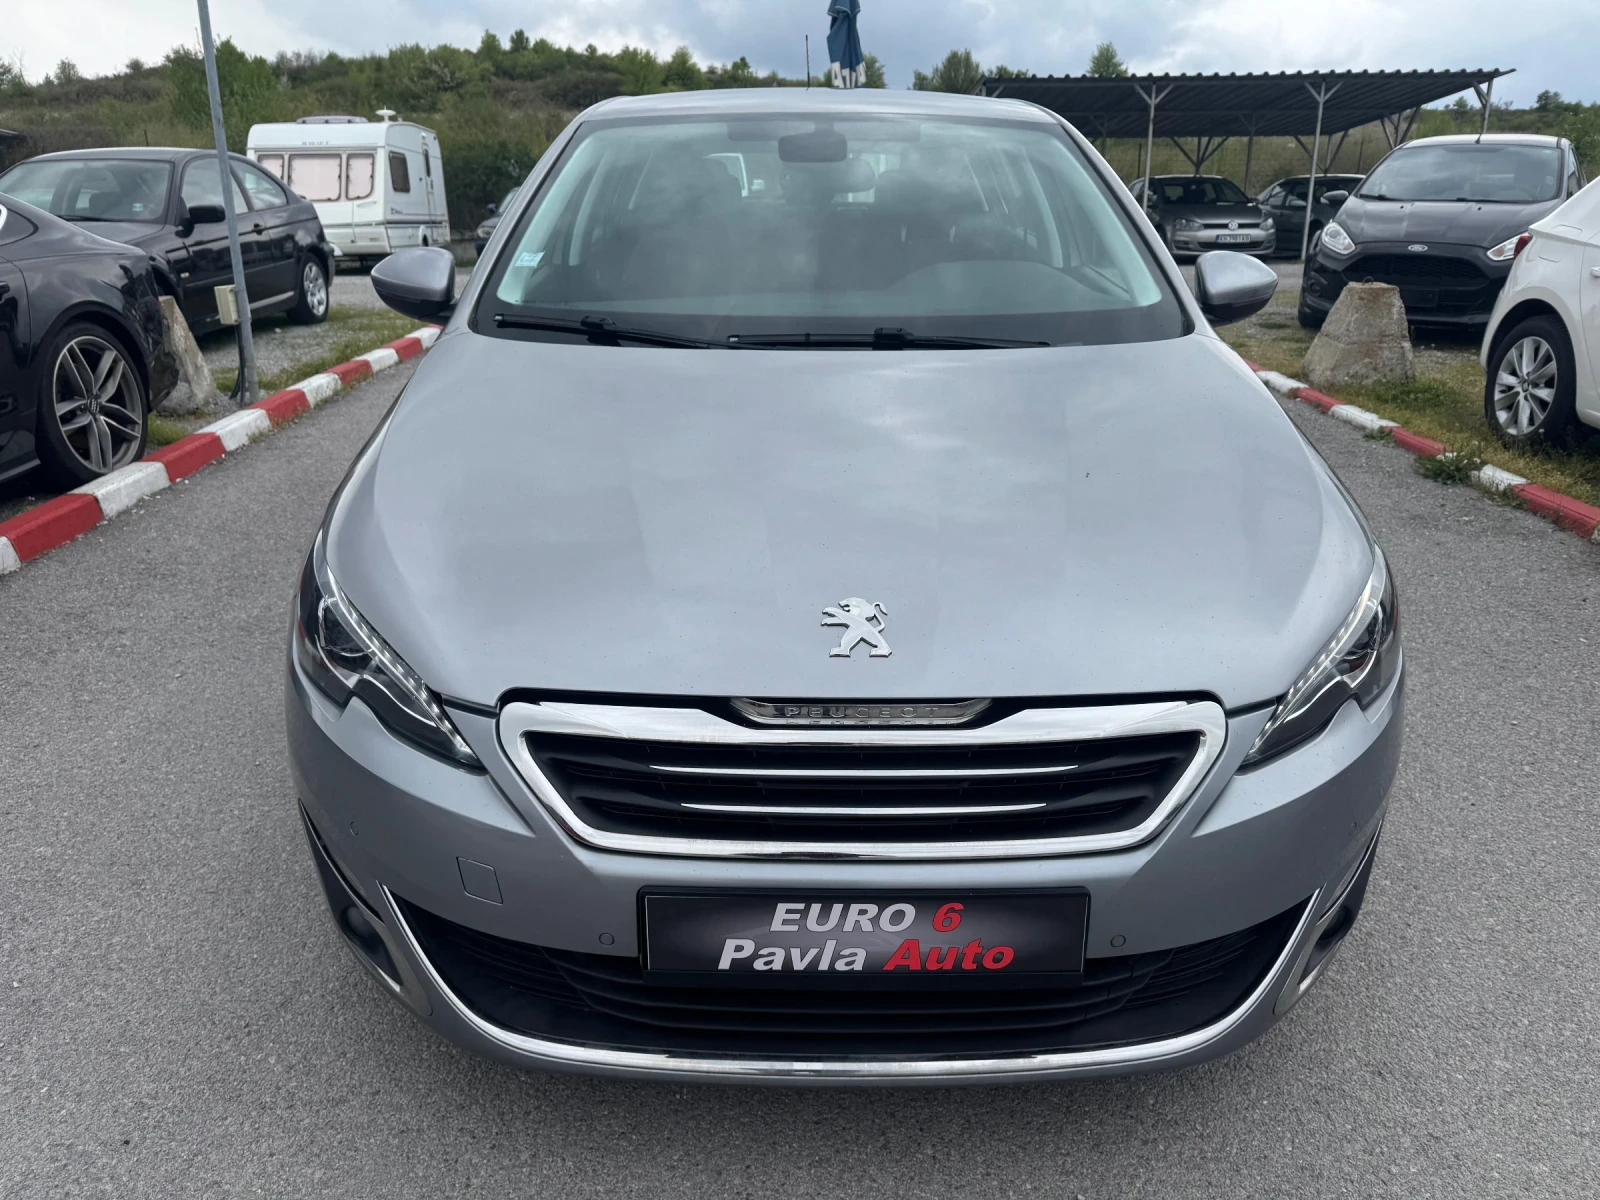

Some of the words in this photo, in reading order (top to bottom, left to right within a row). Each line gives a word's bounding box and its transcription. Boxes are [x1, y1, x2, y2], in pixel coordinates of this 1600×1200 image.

[785, 706, 939, 719] PEUGEOT
[769, 903, 917, 932] EURO
[932, 903, 964, 932] 6
[717, 938, 868, 971] Pavla
[883, 938, 1015, 971] Auto
